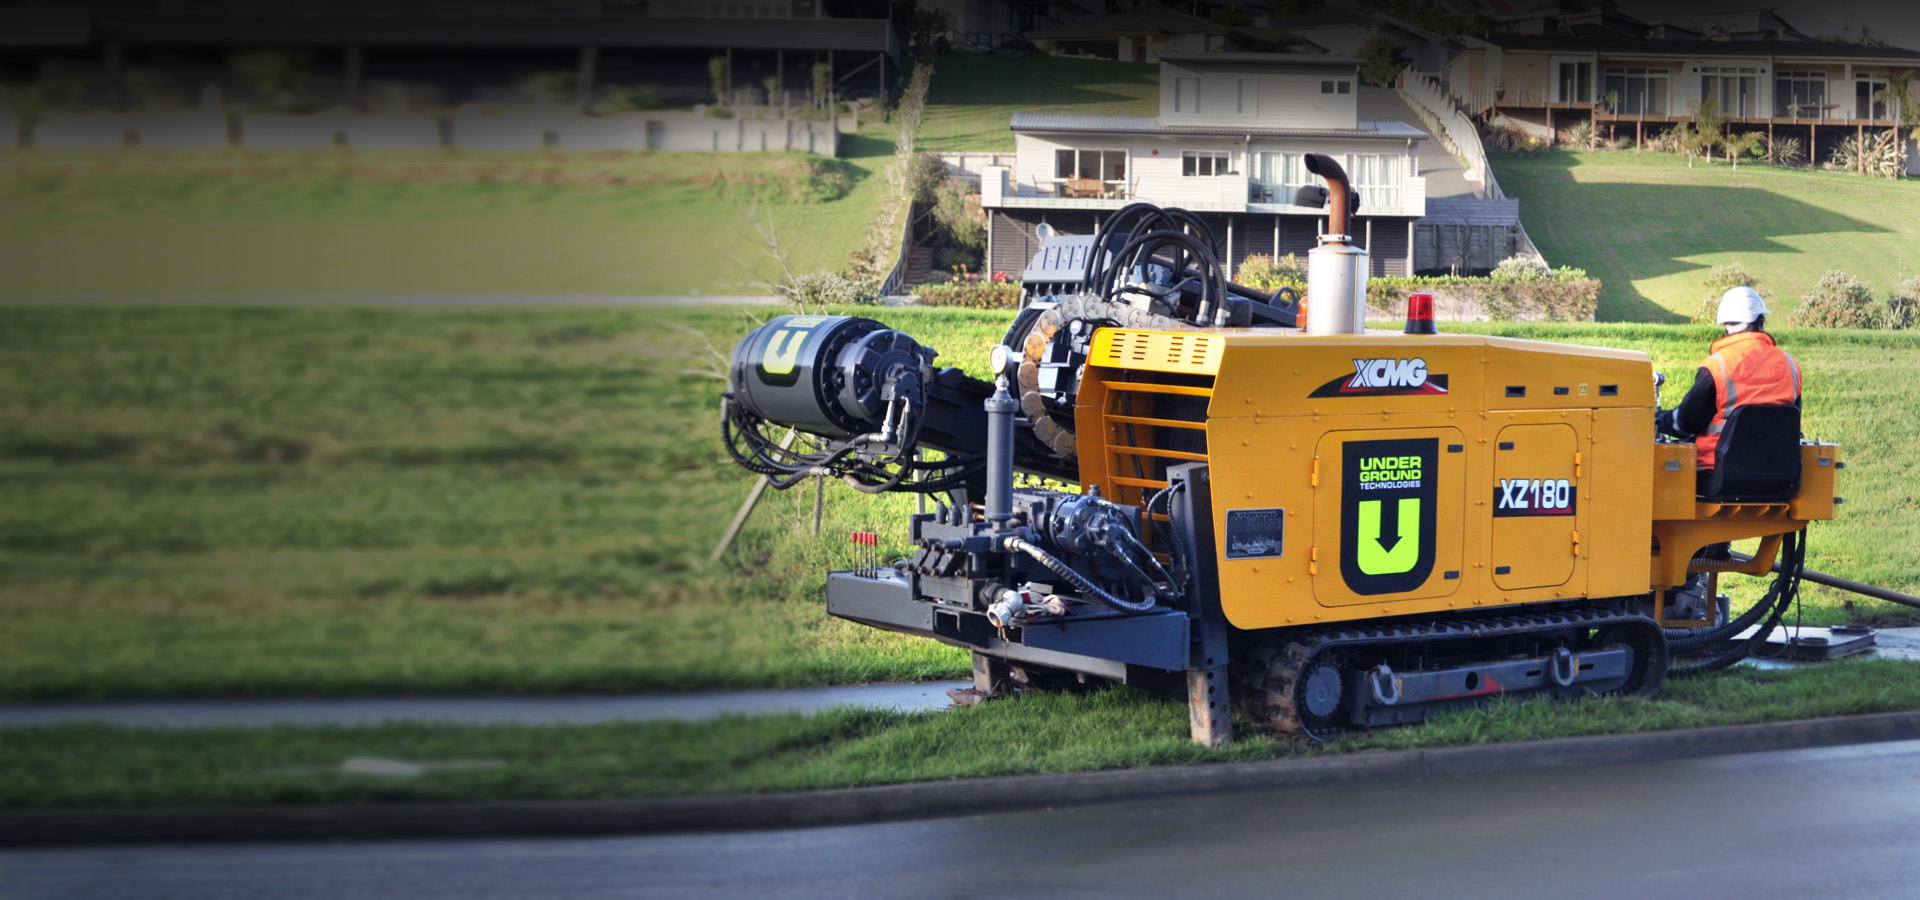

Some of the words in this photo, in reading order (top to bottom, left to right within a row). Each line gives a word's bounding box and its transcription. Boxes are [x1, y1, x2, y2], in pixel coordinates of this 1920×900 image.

[1348, 358, 1428, 388] XCMG
[1360, 456, 1422, 471] UNDER
[1360, 469, 1422, 482] GROUND
[1360, 480, 1421, 490] TECHNOLOGIES
[1498, 479, 1570, 509] XZ180
[1357, 498, 1420, 575] U
